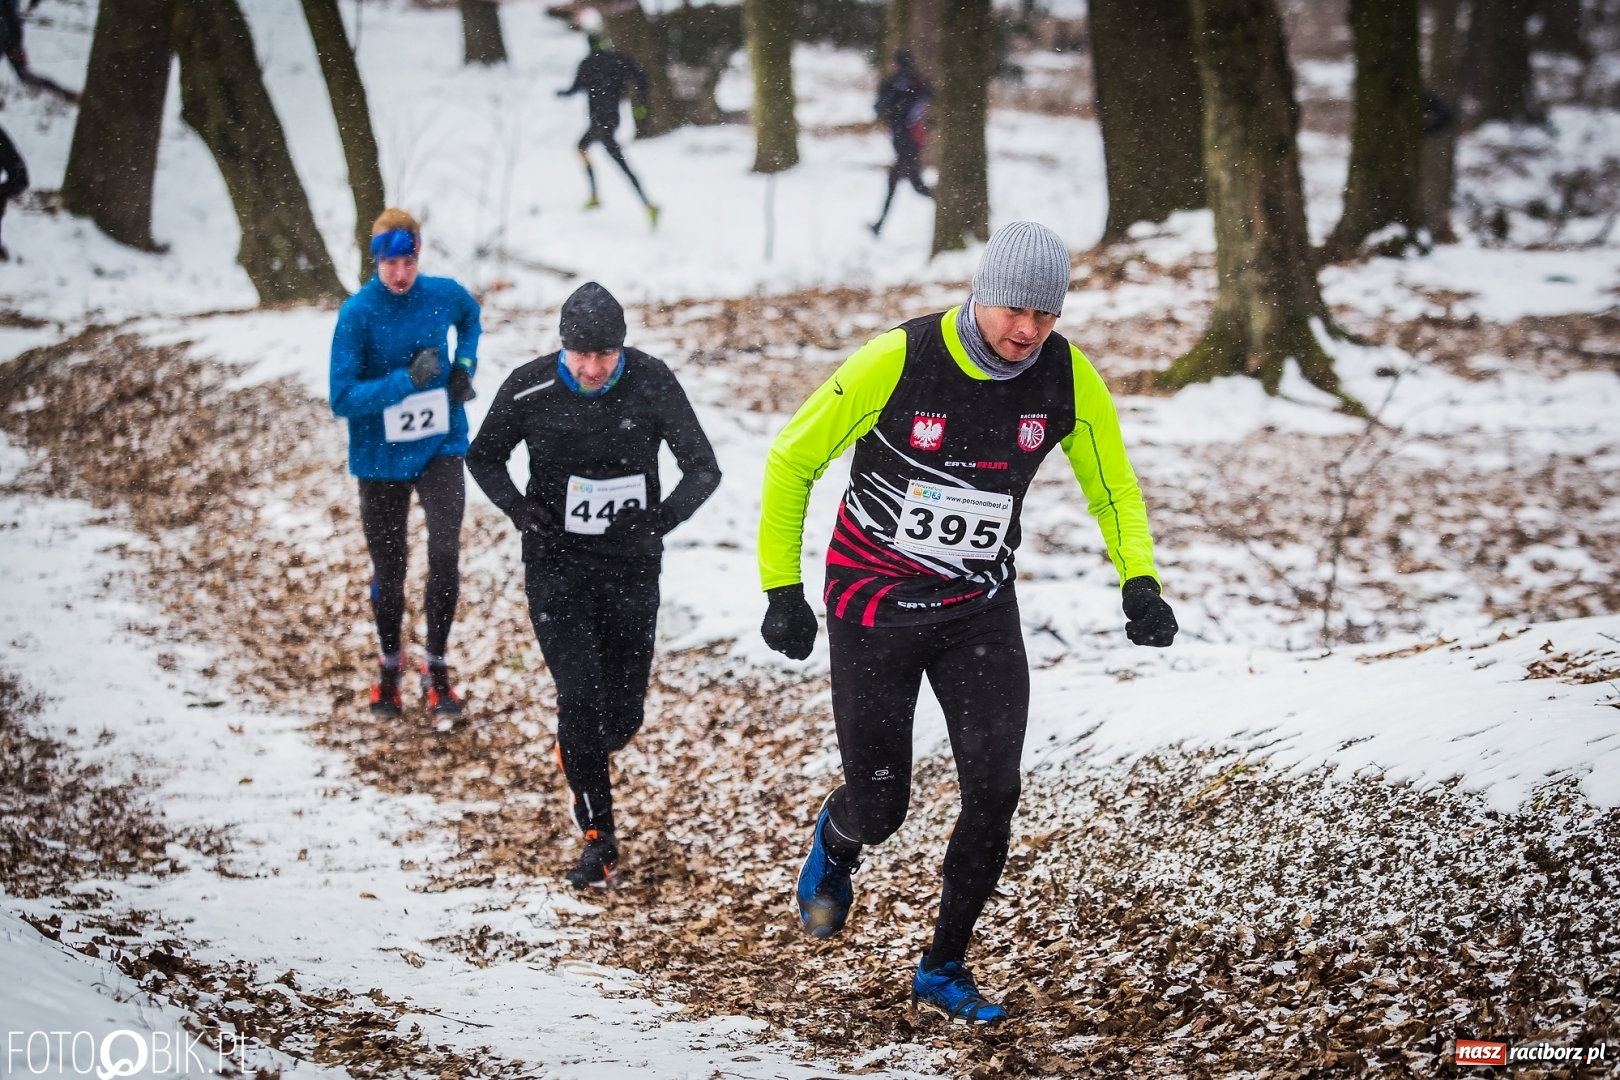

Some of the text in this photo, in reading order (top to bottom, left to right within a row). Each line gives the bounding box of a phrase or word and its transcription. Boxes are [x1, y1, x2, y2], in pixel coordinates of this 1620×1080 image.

[400, 409, 434, 431] 22
[914, 410, 947, 419] POLSKA
[946, 495, 1009, 510] www.personalbest.pl
[904, 507, 1001, 549] 395
